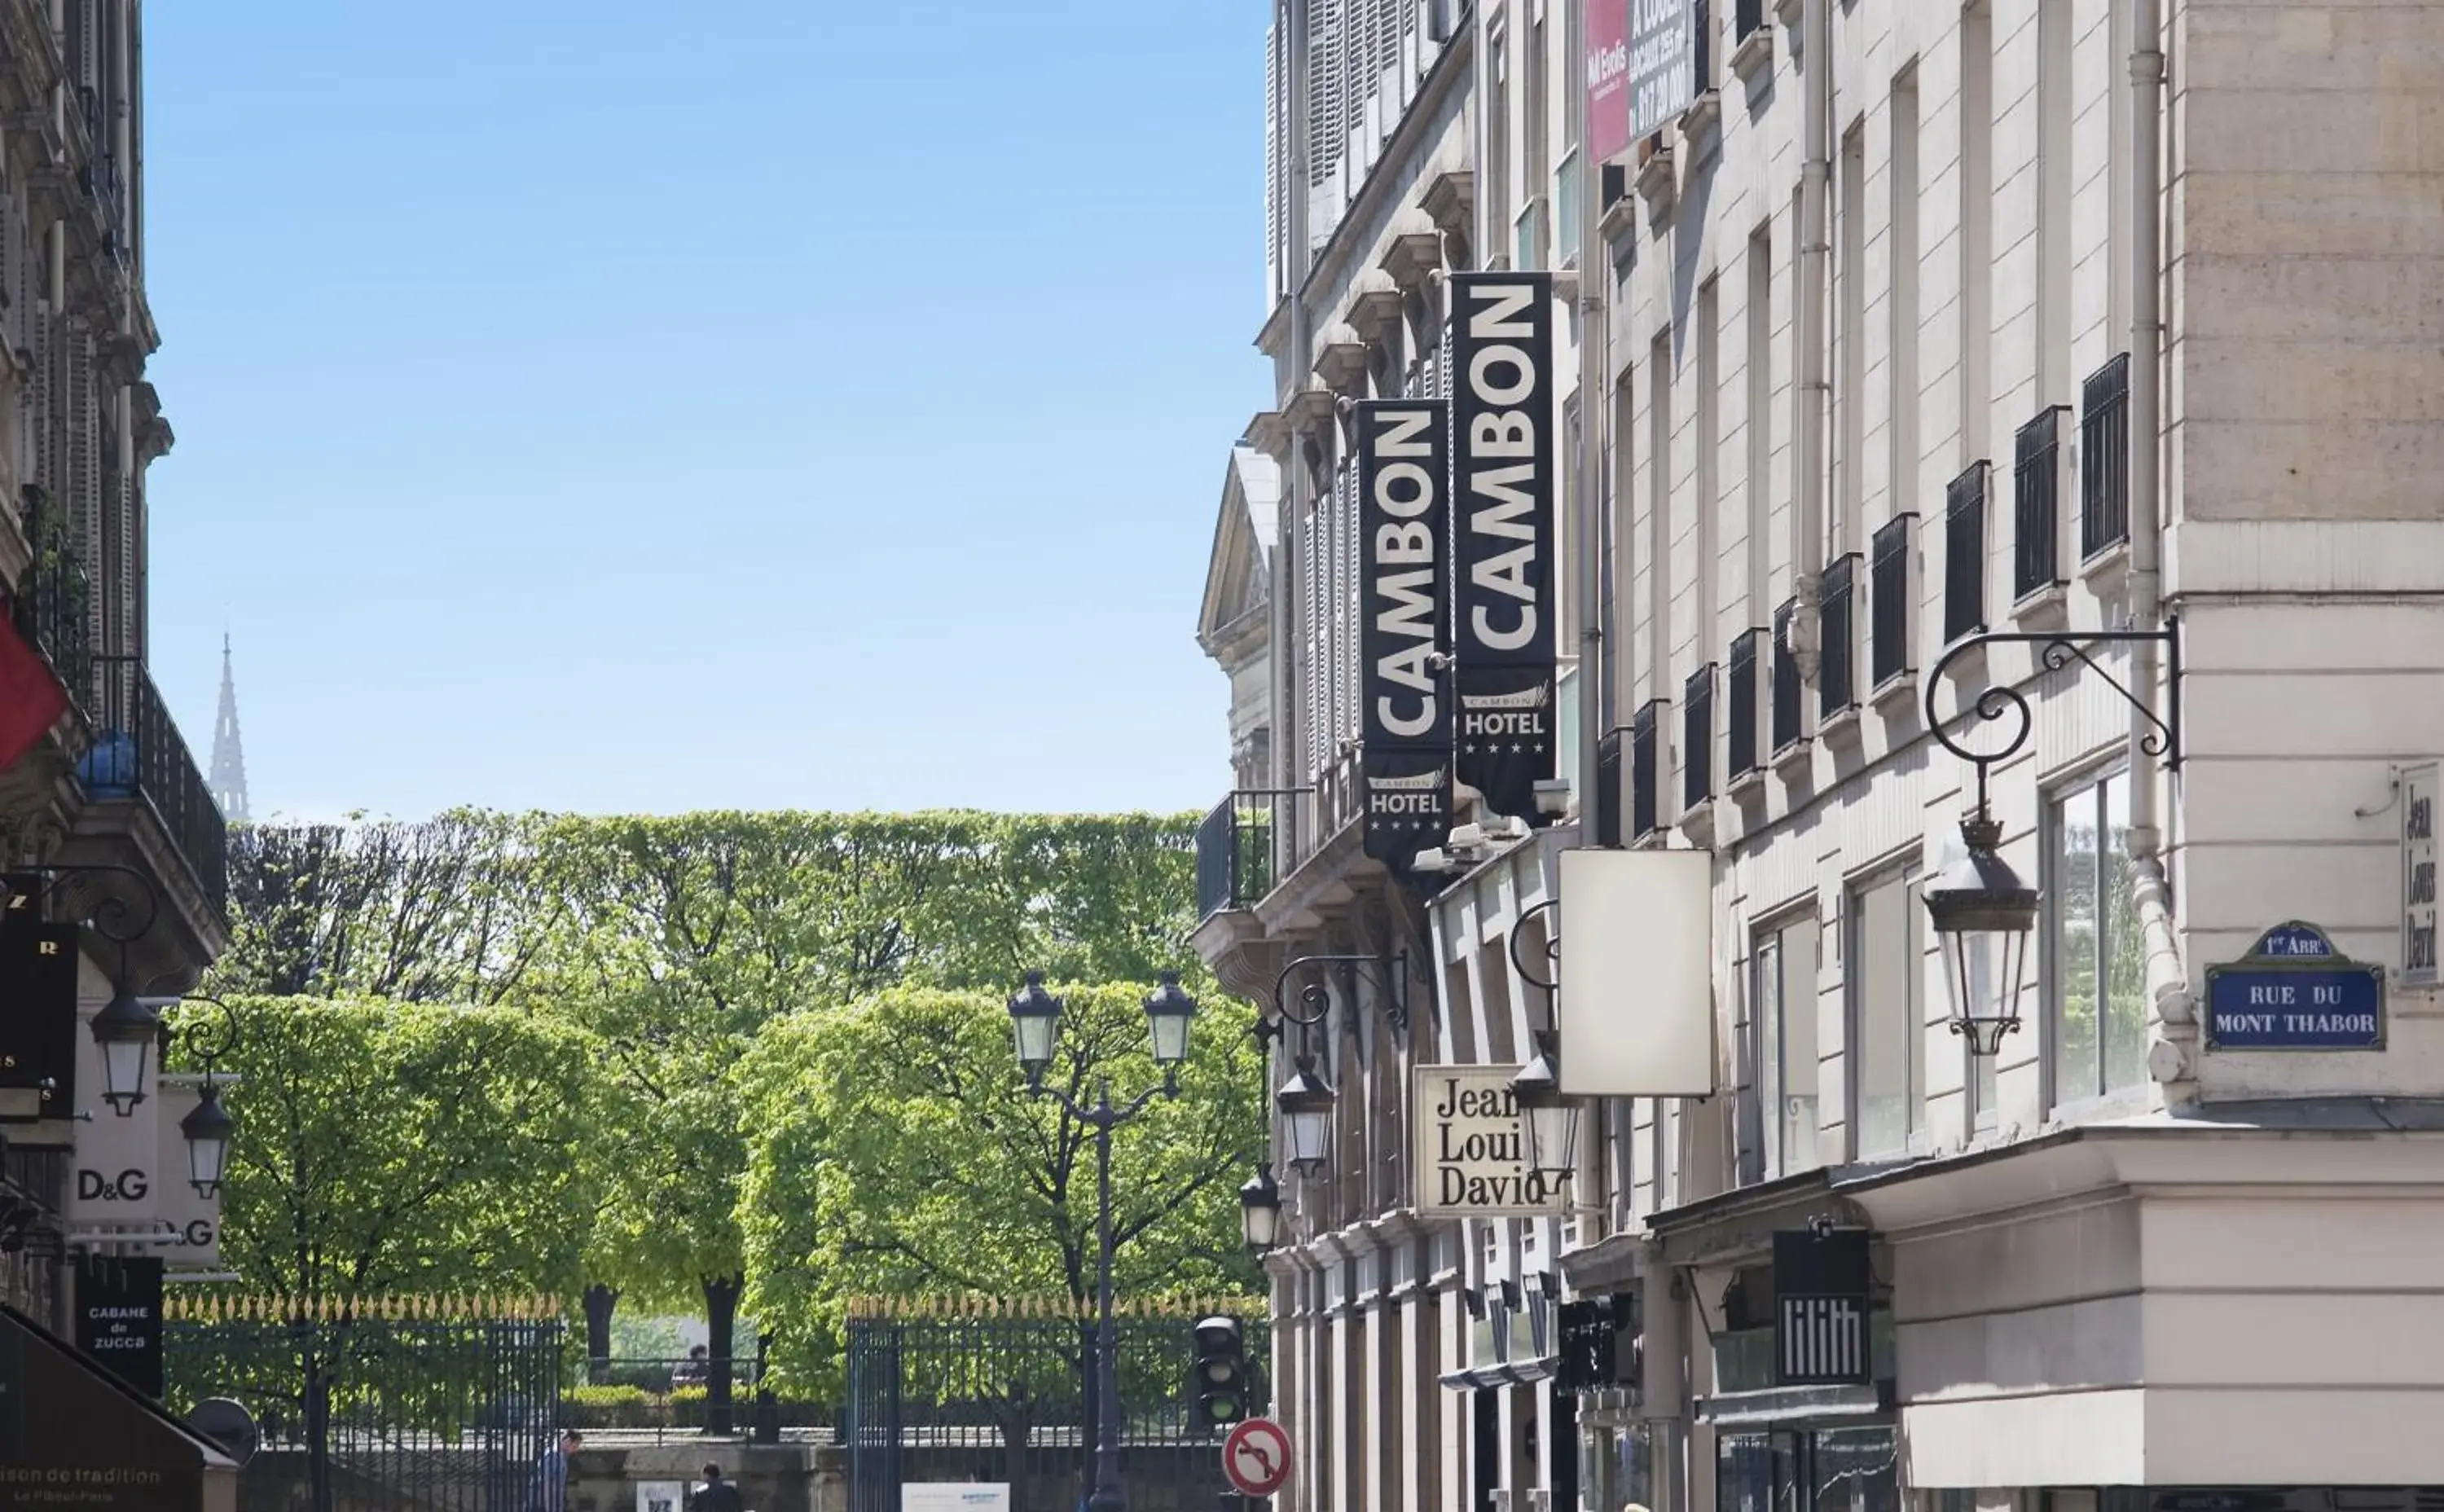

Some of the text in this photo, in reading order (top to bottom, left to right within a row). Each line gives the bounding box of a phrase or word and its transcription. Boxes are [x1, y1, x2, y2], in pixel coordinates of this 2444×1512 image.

[1469, 284, 1537, 651] CAMBON
[1374, 410, 1436, 736] CAMBON
[1465, 713, 1545, 735] HOTEL
[1370, 793, 1442, 814] HOTEL
[2249, 986, 2343, 1004] RUE DU
[2216, 1013, 2376, 1033] MONT THABOR
[1436, 1078, 1519, 1119] Jean
[1436, 1122, 1524, 1163] Loui
[77, 1168, 148, 1201] D&G
[1437, 1165, 1547, 1207] David
[89, 1307, 149, 1319] CABANE
[110, 1322, 128, 1334] de
[1785, 1299, 1862, 1376] lilith
[75, 1466, 161, 1484] tradition
